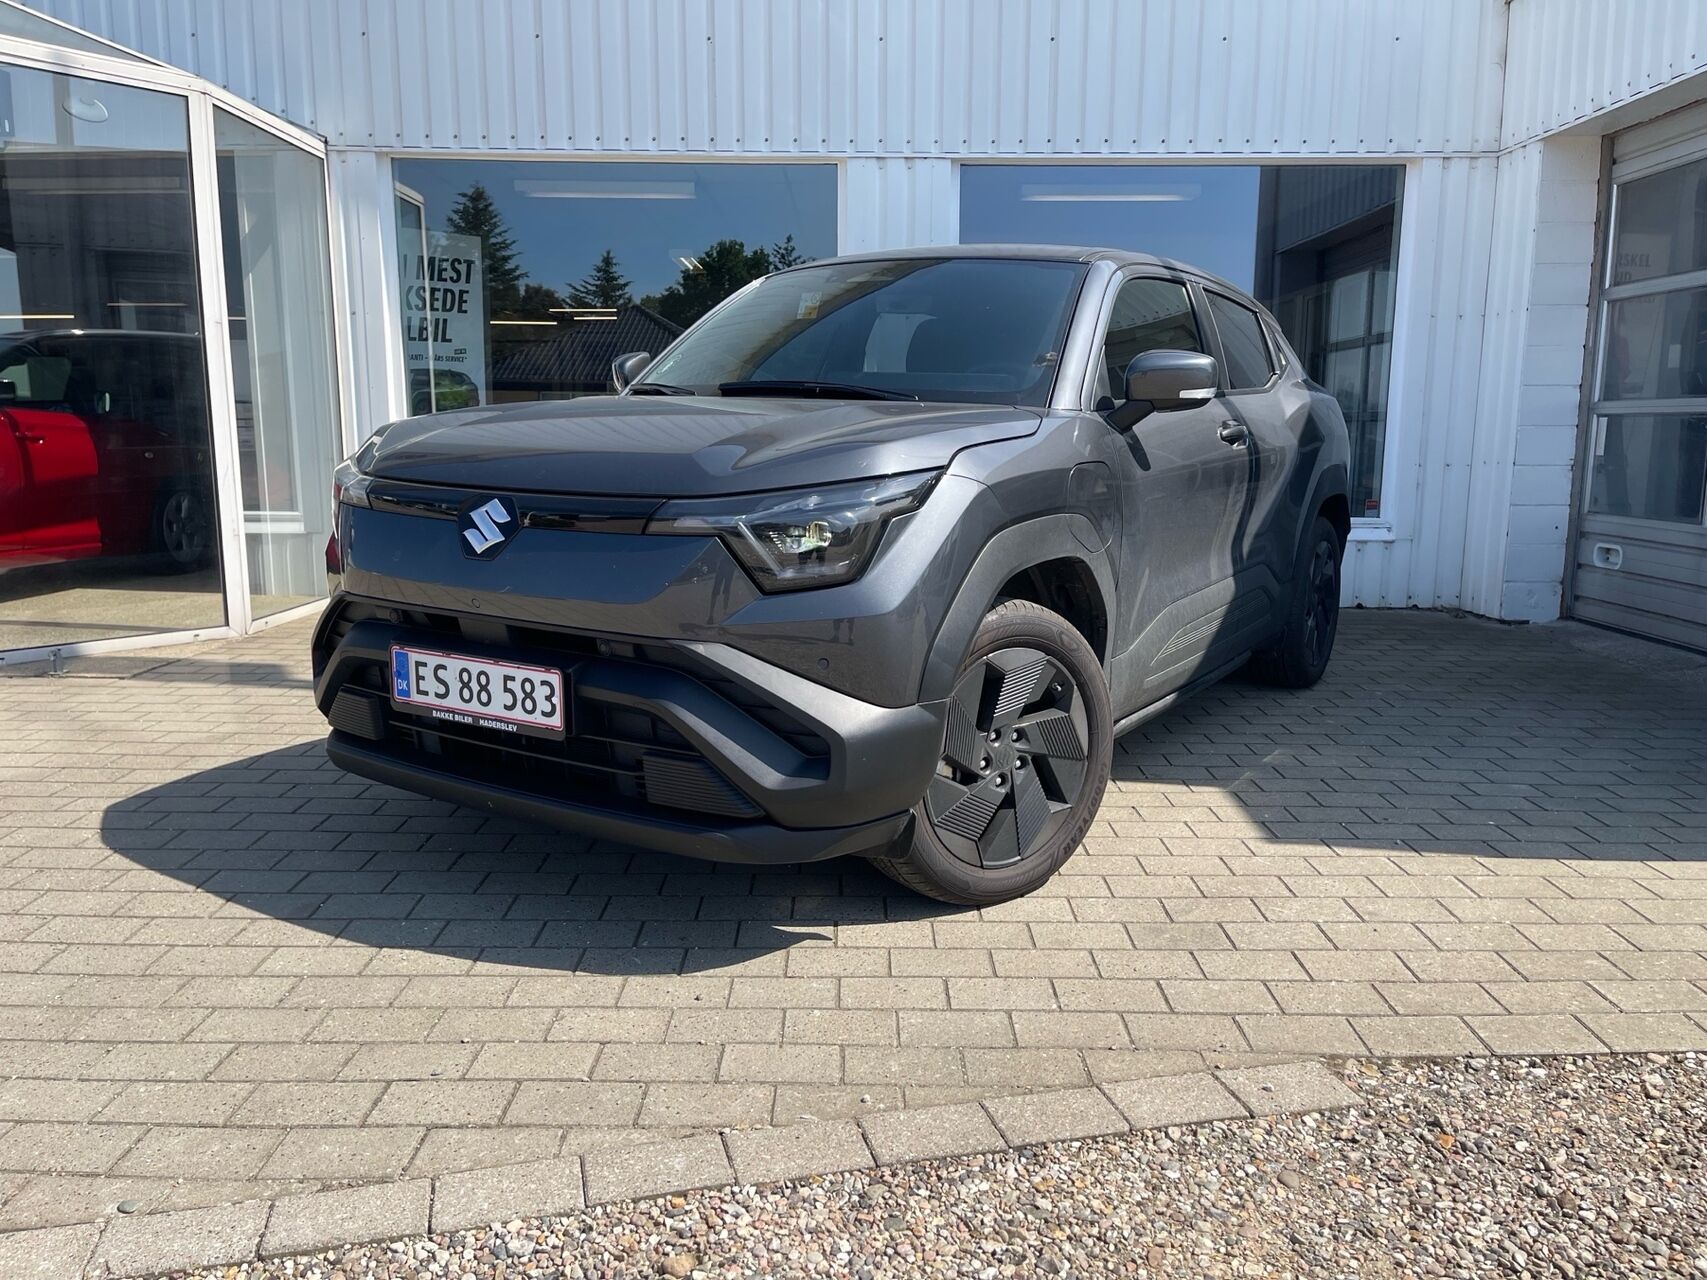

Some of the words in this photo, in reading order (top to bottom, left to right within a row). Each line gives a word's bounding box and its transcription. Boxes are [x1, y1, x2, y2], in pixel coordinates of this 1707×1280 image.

[416, 254, 475, 284] MEST
[398, 679, 408, 691] DK
[414, 660, 450, 699] ES
[458, 667, 492, 707] 88
[503, 674, 557, 717] 583
[455, 714, 473, 724] BILER
[479, 718, 517, 732] HADERSLEV
